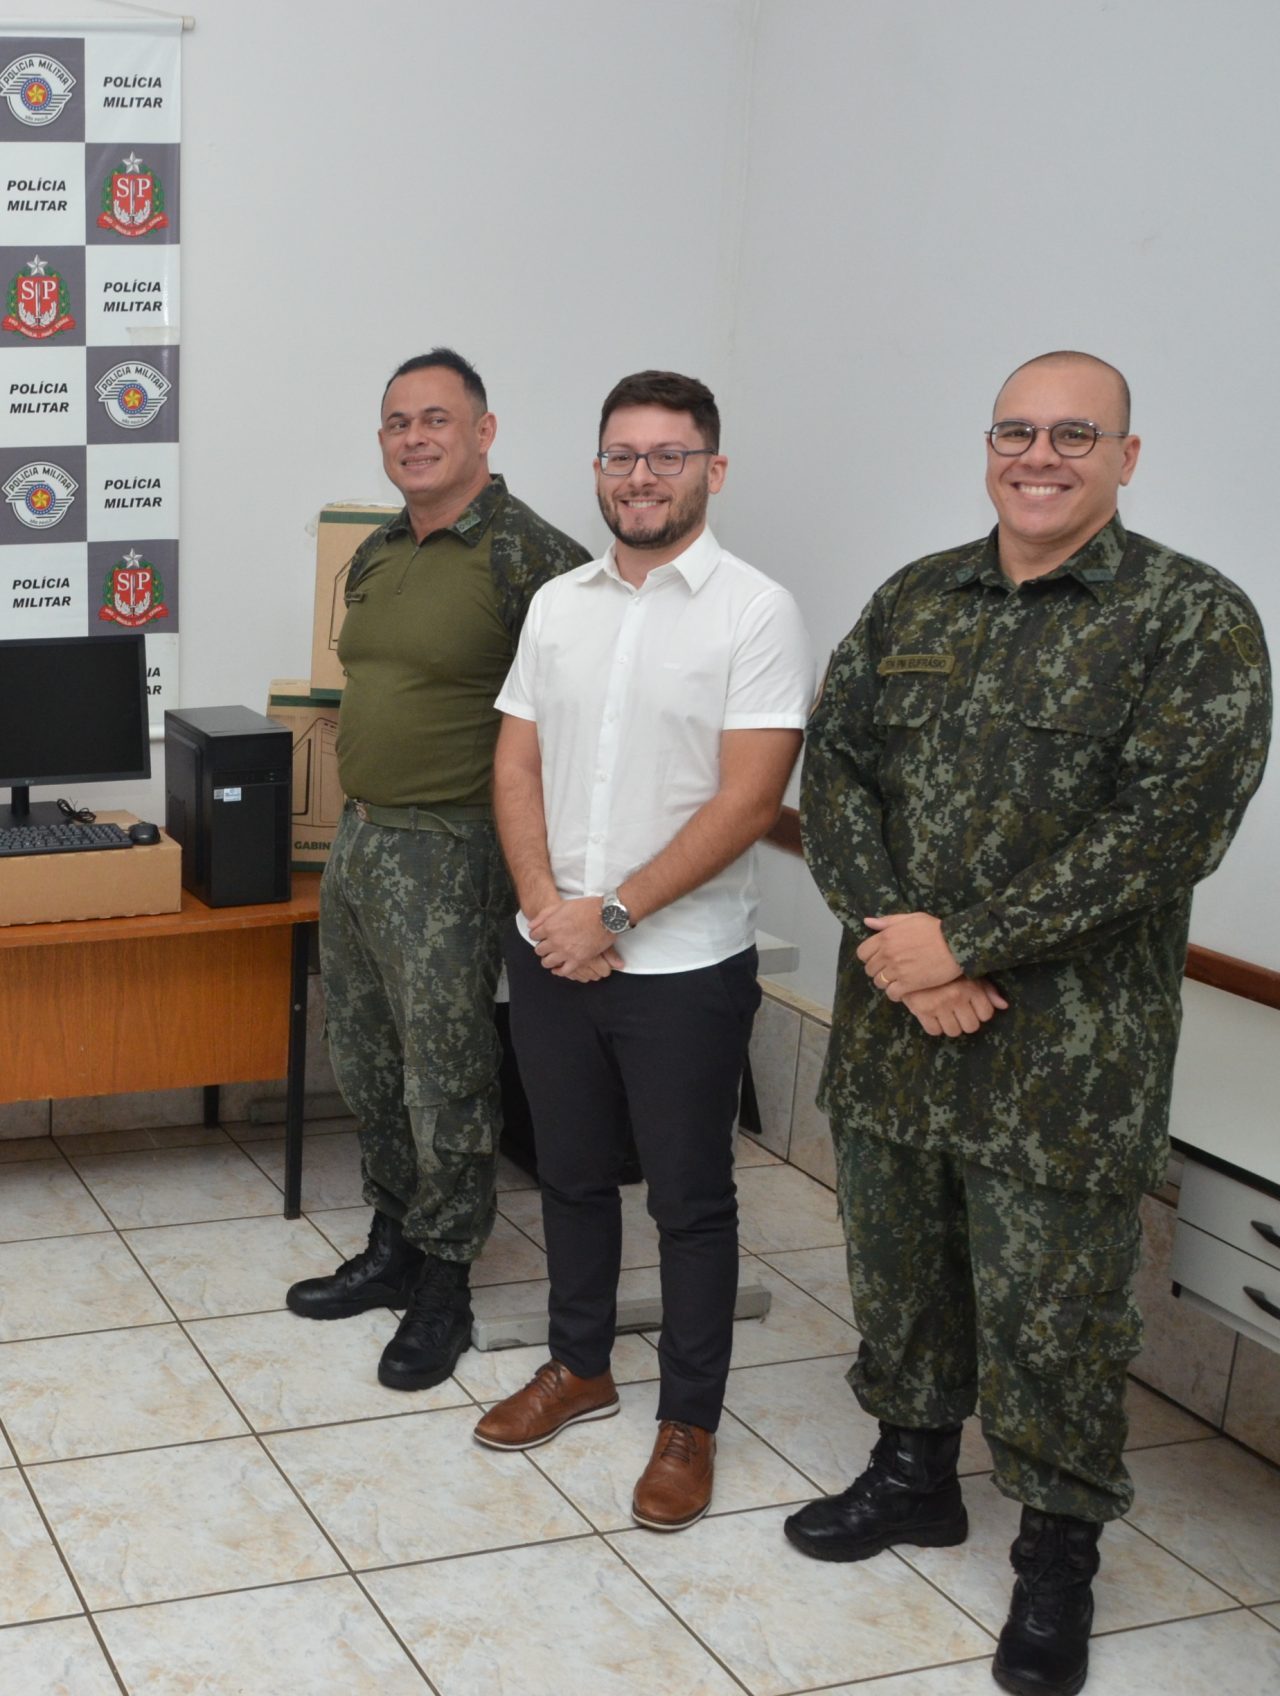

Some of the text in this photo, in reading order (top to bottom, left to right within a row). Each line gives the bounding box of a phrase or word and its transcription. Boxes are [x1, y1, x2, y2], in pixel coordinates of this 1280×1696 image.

[38, 59, 70, 85] MILITAR
[103, 74, 162, 88] POLÍCIA
[103, 96, 163, 108] MILITAR
[6, 177, 66, 192] POLÍCIA
[7, 200, 68, 211] MILITAR
[103, 279, 161, 293] POLÍCIA
[103, 300, 163, 312] MILITAR
[135, 366, 165, 390] MILITAR
[9, 380, 68, 395] POLÍCIA
[9, 401, 70, 414] MILITAR
[42, 467, 72, 490] MILITAR
[104, 476, 161, 491] POLÍCIA
[104, 496, 163, 509] MILITAR
[12, 576, 70, 590] POLÍCIA
[12, 595, 72, 609] MILITAR
[294, 841, 332, 850] GABIN
